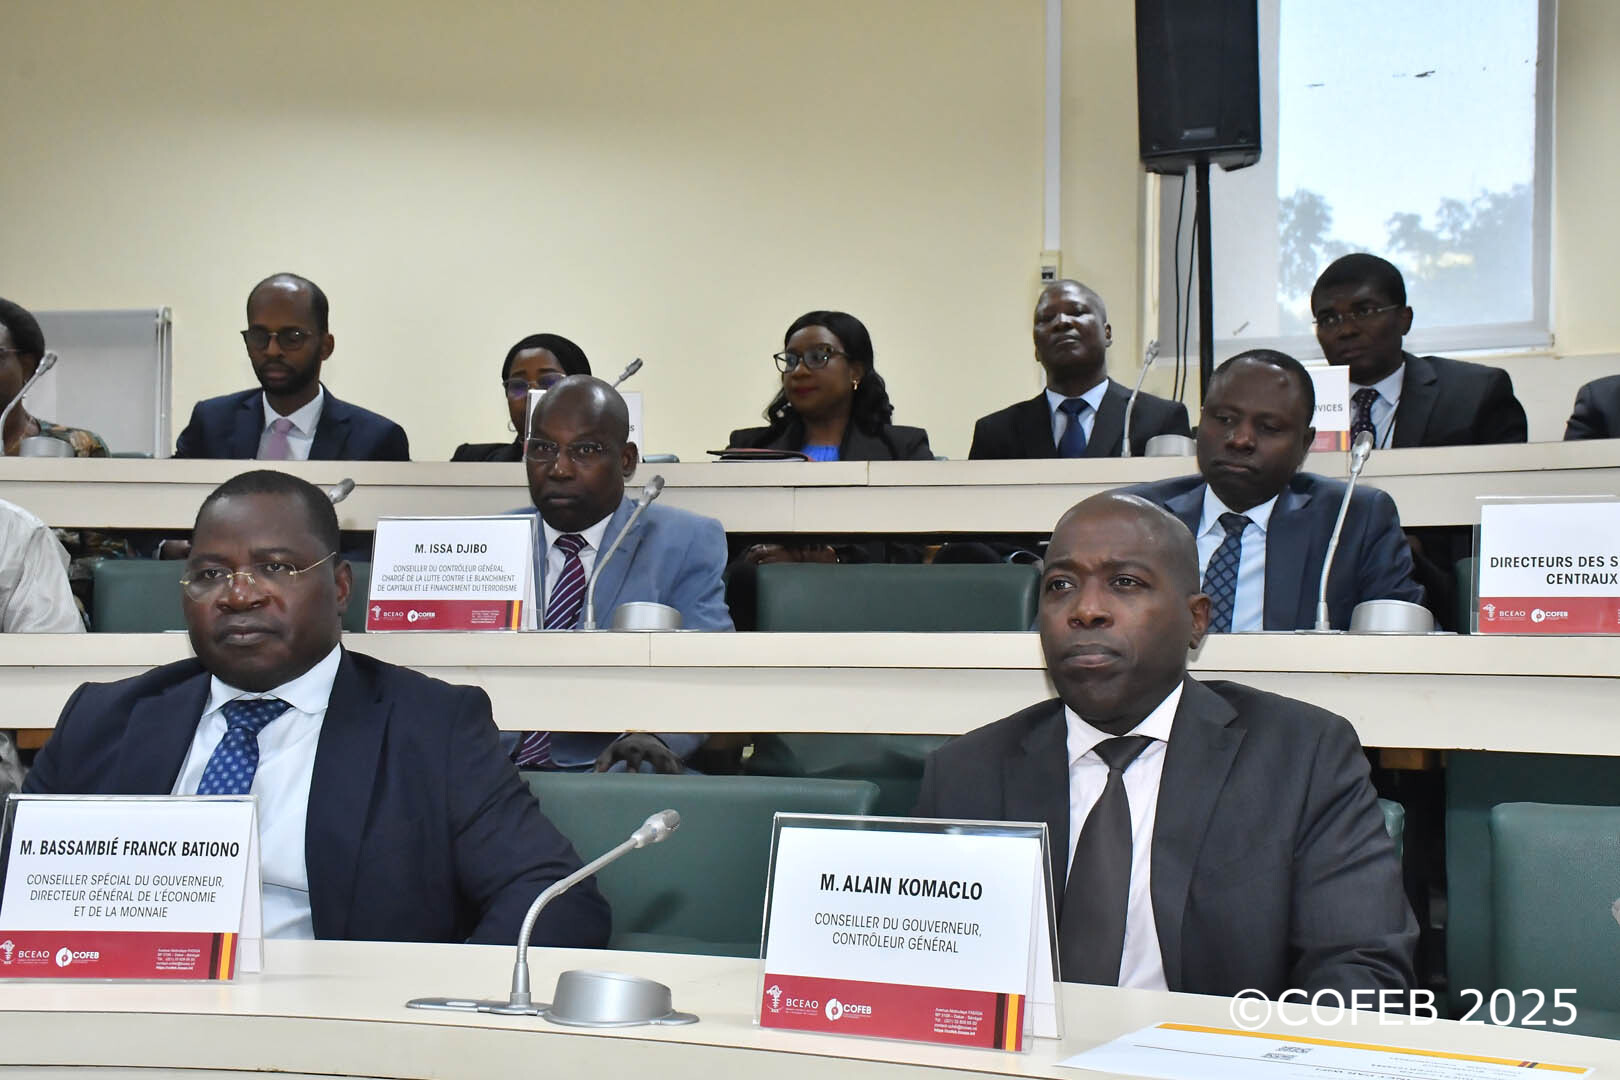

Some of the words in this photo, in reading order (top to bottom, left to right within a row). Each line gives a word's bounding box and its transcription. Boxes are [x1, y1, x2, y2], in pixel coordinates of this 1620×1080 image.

[415, 544, 426, 553] M.
[430, 544, 452, 553] ISSA
[457, 544, 487, 553] DJIBO
[1491, 556, 1572, 567] DIRECTEURS
[1579, 556, 1604, 567] DES
[393, 564, 427, 572] CONSEILLER
[429, 564, 437, 572] DU
[439, 564, 477, 573] CONTRÔLEUR
[382, 573, 404, 582] CHARGÉ
[407, 574, 414, 582] DE
[424, 574, 441, 582] LUTTE
[1547, 573, 1617, 584] CENTRAUX
[387, 584, 413, 592] CAPITAUX
[482, 583, 517, 592] TERRORISME
[20, 840, 35, 855] M.
[40, 837, 118, 855] BASSAMBIÉ
[123, 841, 177, 856] FRANCK
[182, 842, 239, 857] BATIONO
[27, 874, 88, 885] CONSEILLER
[91, 873, 131, 885] SPÉCIAL
[135, 875, 149, 885] DU
[153, 875, 224, 888] GOUVERNEUR,
[821, 874, 839, 891] M.
[843, 875, 891, 894] ALAIN
[899, 878, 982, 900] KOMACLO
[30, 890, 86, 901] DIRECTEUR
[89, 888, 133, 901] GÉNÉRAL
[138, 891, 151, 901] DE
[155, 889, 216, 902] L'ÉCONOMIE
[74, 906, 86, 916] ET
[89, 906, 102, 917] DE
[105, 906, 116, 917] LA
[120, 907, 168, 917] MONNAIE
[815, 913, 879, 928] CONSEILLER
[883, 917, 898, 930] DU
[902, 919, 981, 937] GOUVERNEUR,
[833, 931, 904, 949] CONTRÔLEUR
[908, 935, 958, 953] GÉNÉRAL
[73, 951, 99, 959] COFEB
[786, 998, 818, 1008] BCEAO
[843, 1004, 871, 1014] COFEB
